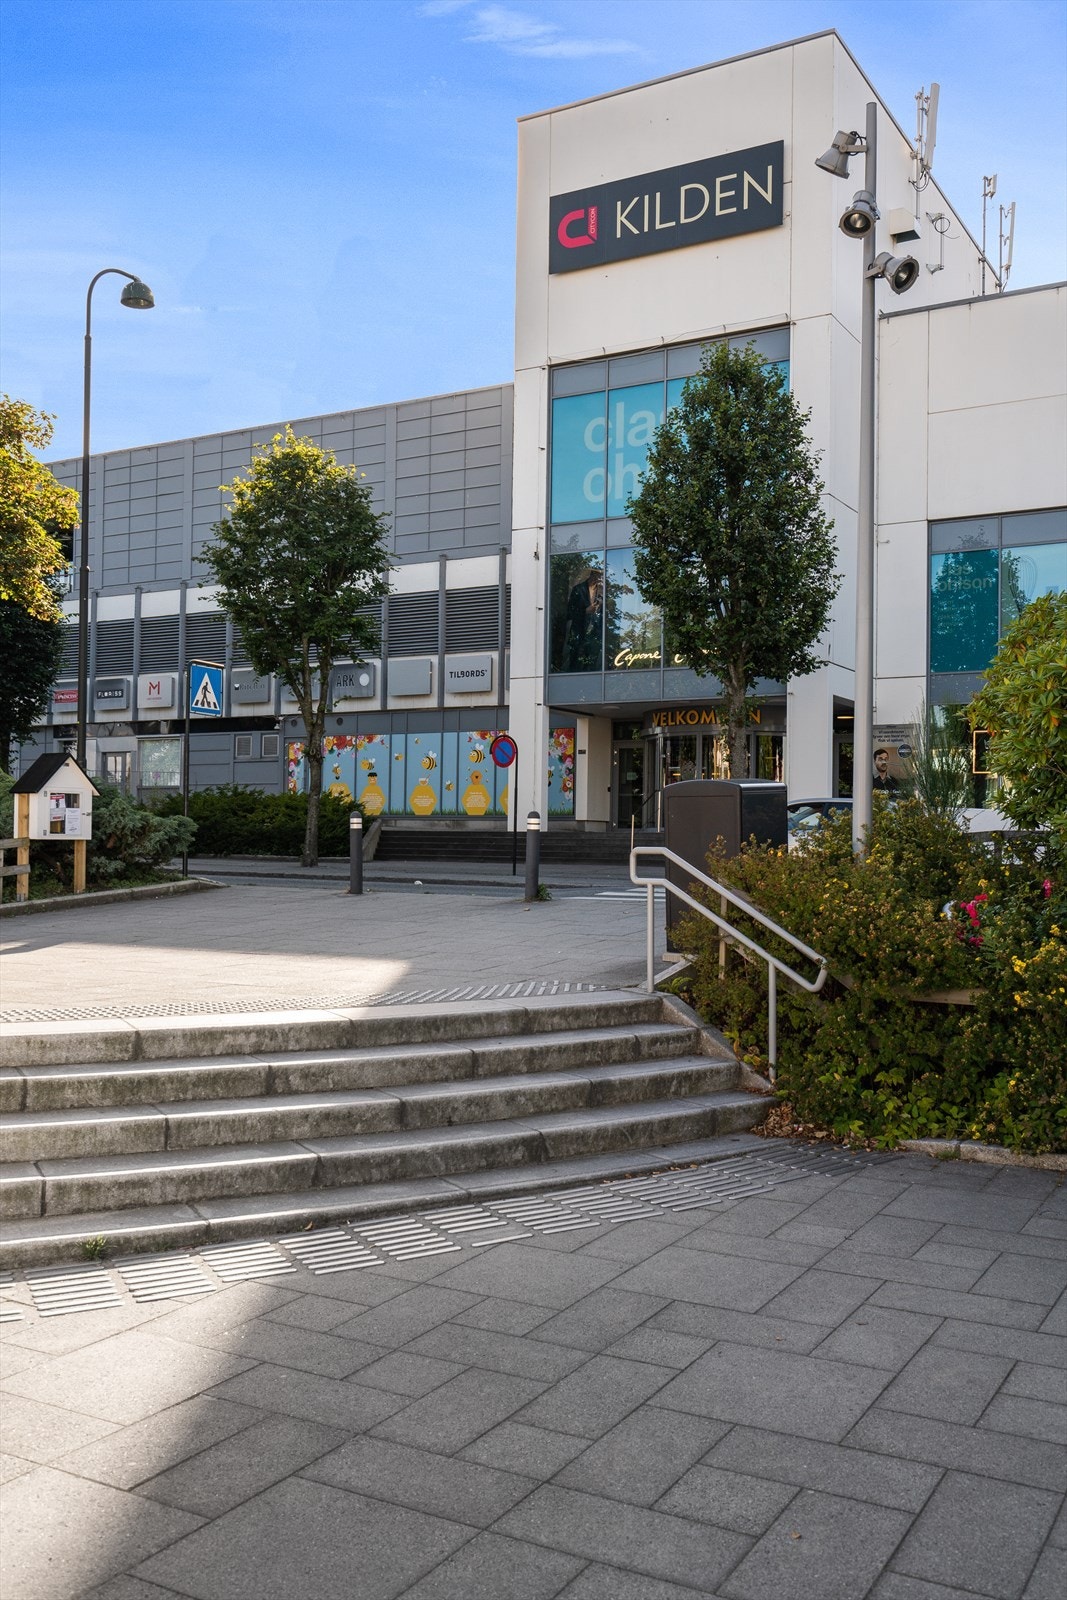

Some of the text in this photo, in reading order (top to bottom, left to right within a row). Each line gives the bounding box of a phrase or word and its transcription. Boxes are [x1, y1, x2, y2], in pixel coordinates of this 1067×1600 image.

[616, 165, 773, 239] KILDEN
[614, 648, 662, 667] Capone
[336, 674, 355, 687] ARK
[449, 669, 487, 679] TILBORDS
[652, 708, 761, 727] VELKOMN
